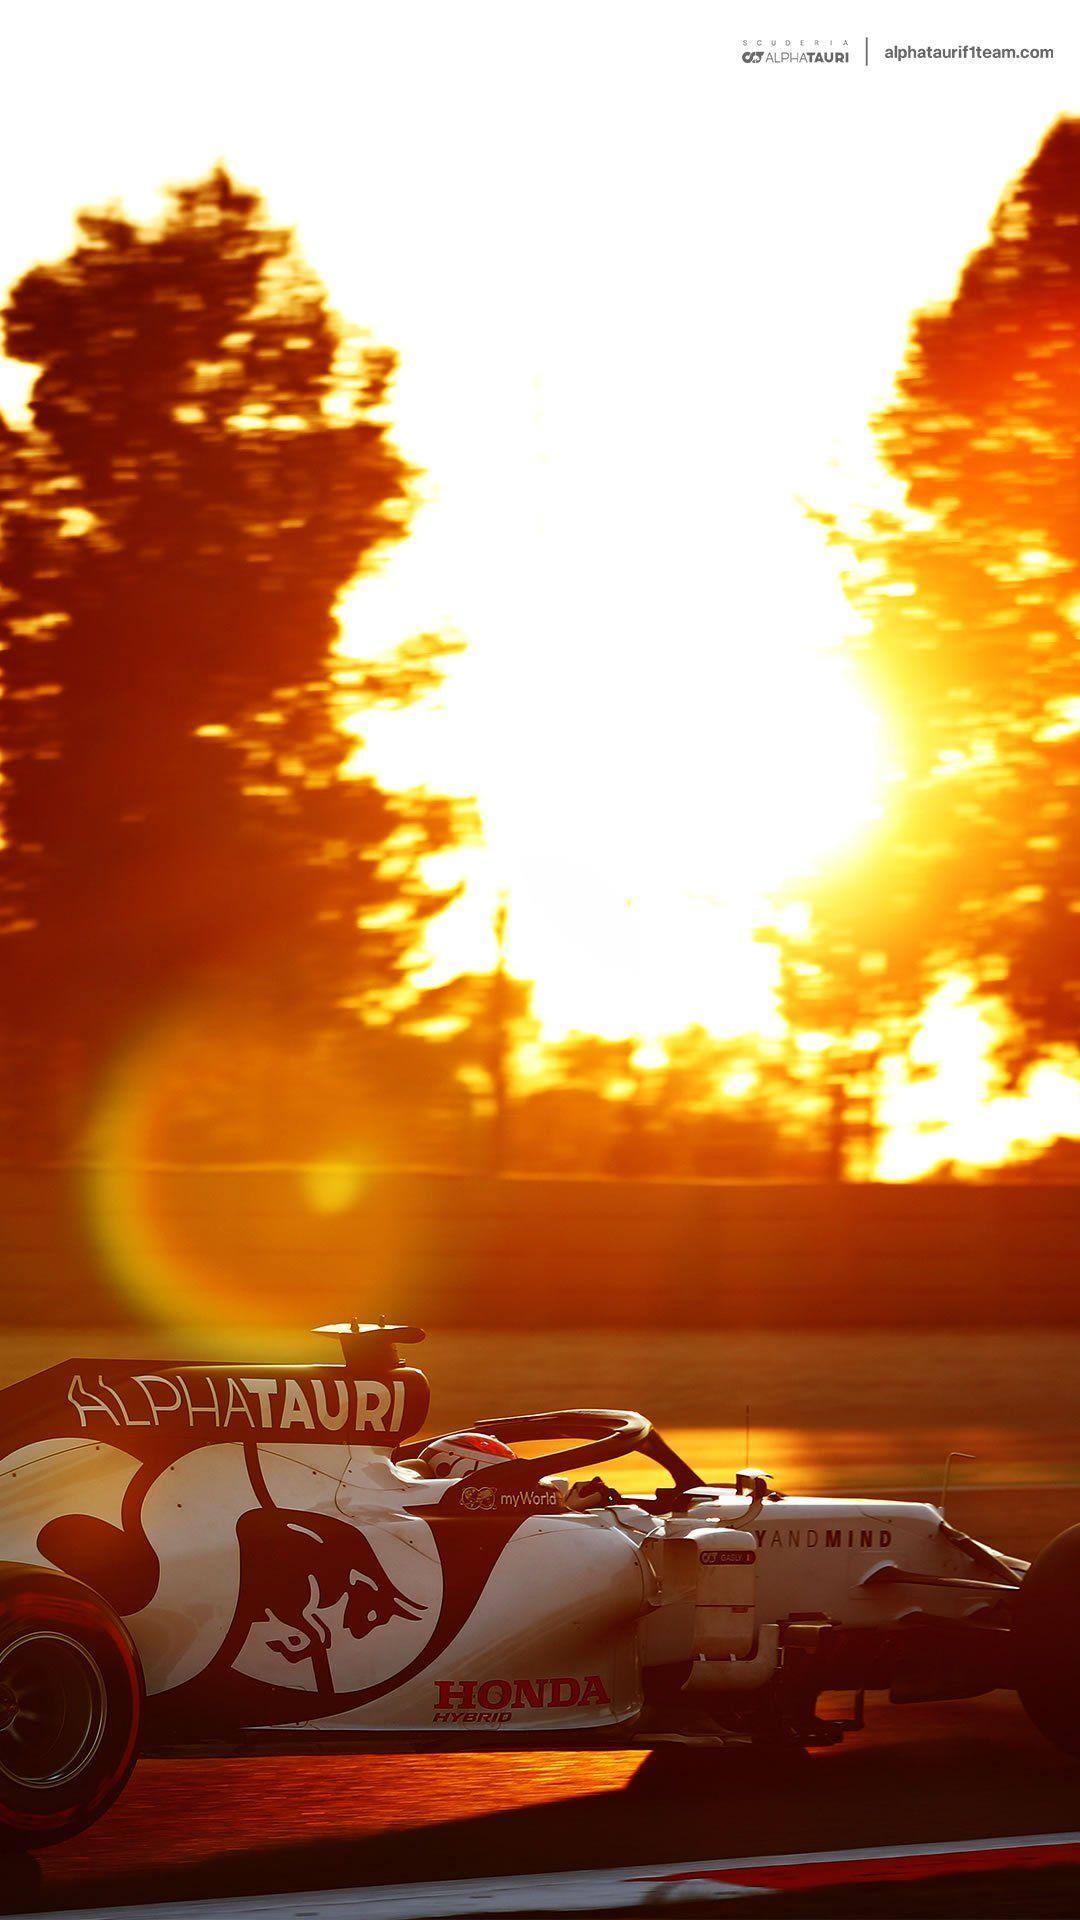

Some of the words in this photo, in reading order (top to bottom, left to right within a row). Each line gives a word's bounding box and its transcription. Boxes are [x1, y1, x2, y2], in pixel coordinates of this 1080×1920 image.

[67, 1374, 406, 1433] ALPHATAURI
[501, 1491, 557, 1507] myWorld
[433, 1676, 611, 1710] HONDA
[432, 1712, 512, 1723] HYBRID
